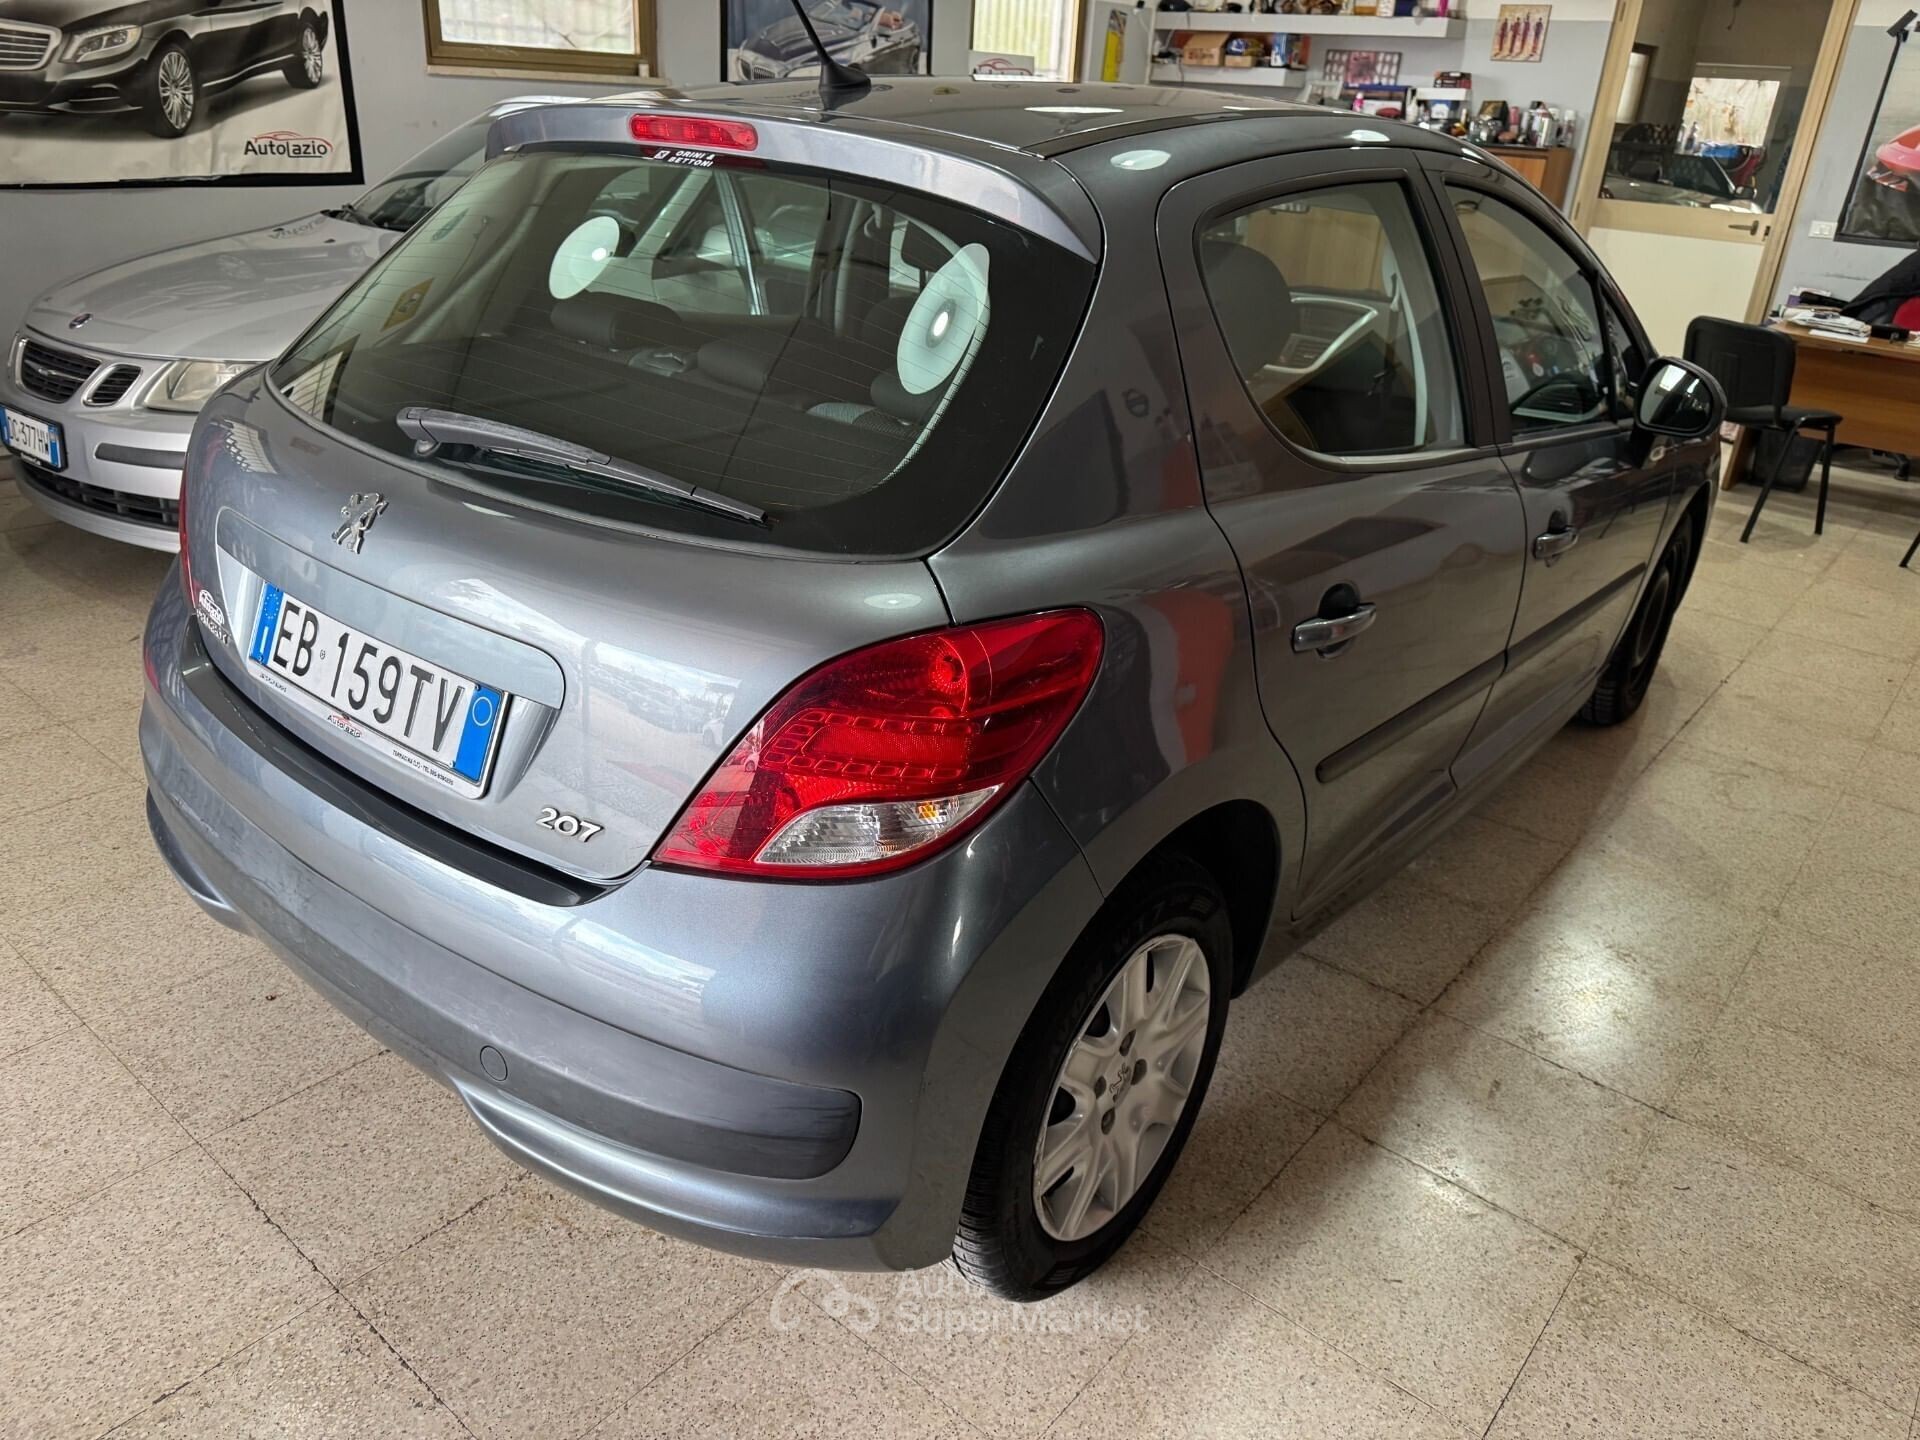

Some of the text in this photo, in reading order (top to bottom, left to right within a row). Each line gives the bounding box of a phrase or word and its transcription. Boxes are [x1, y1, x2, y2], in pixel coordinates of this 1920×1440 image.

[668, 157, 714, 167] BETTONI
[676, 150, 705, 159] ORINI
[272, 600, 466, 753] EB 159TV
[536, 806, 604, 843] 207
